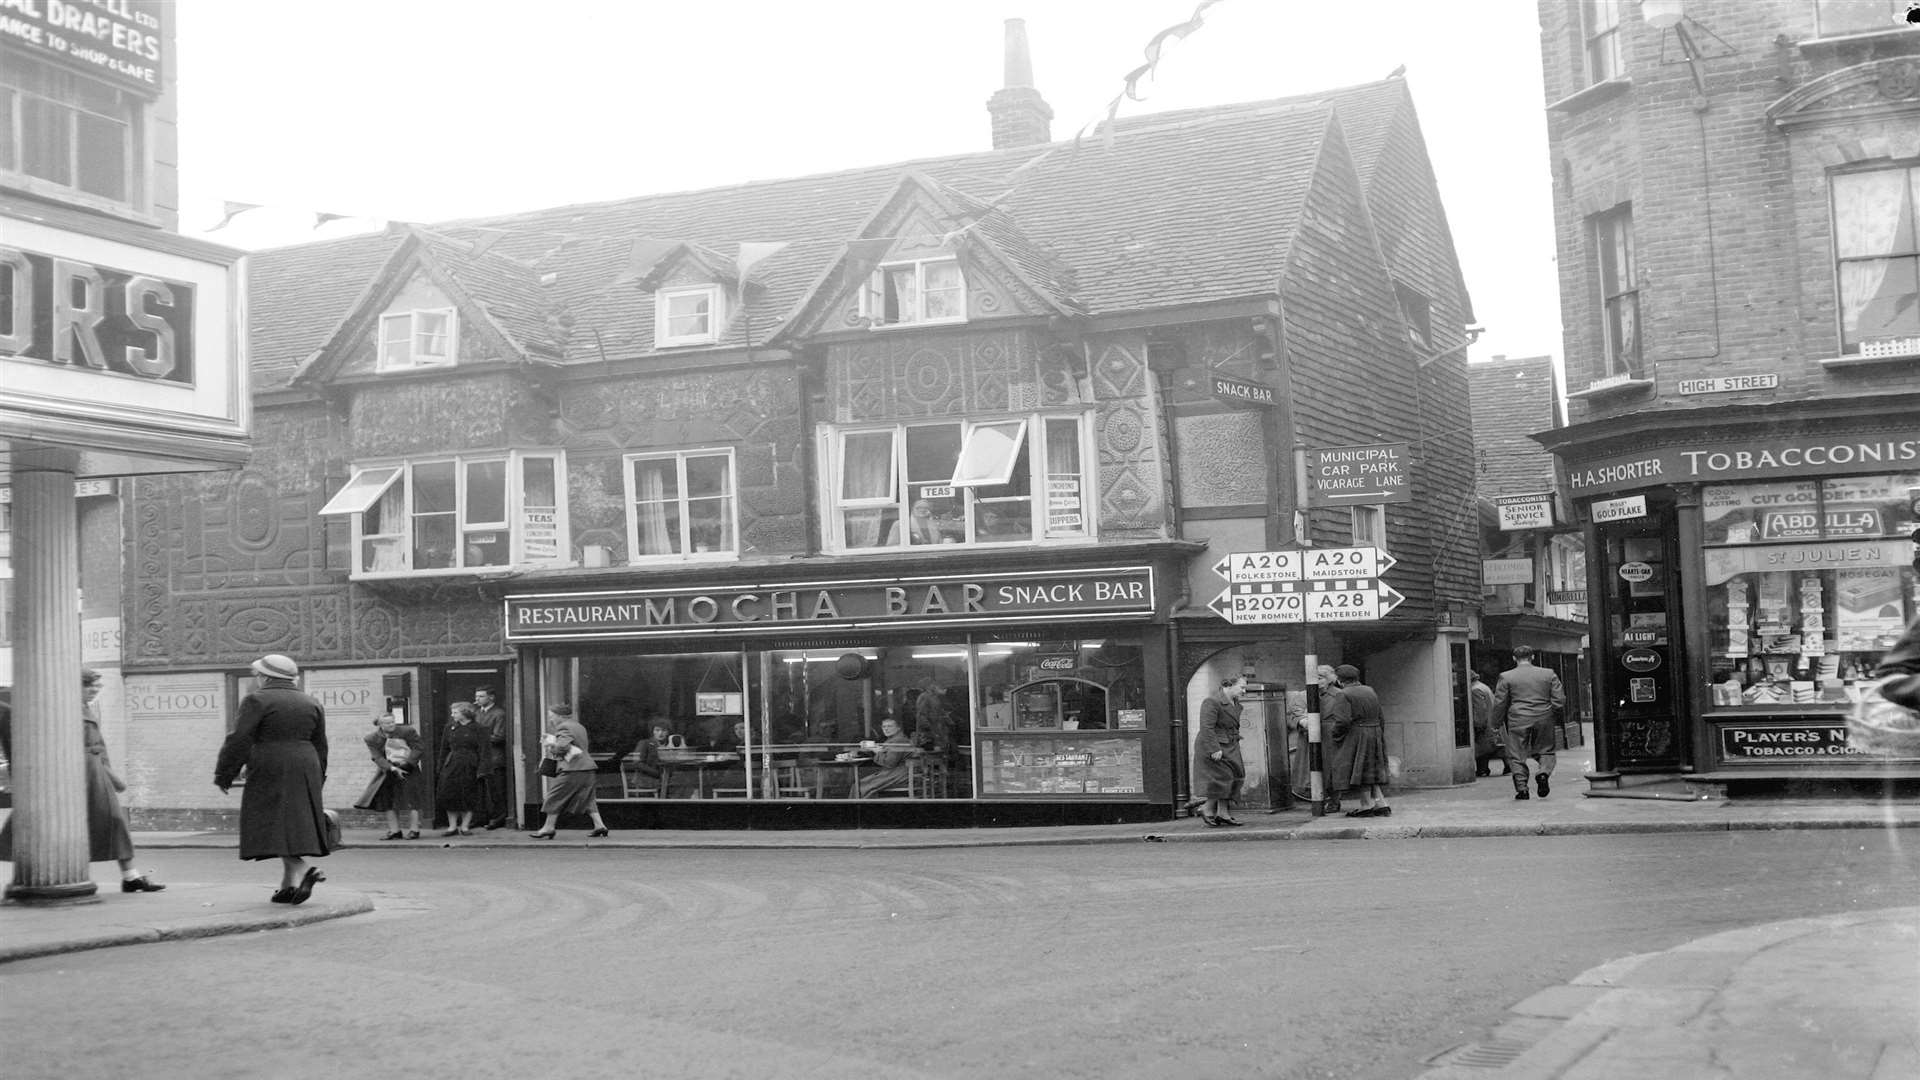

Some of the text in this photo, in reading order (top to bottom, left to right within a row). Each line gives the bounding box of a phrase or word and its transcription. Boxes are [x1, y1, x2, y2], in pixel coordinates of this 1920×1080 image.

[48, 0, 159, 61] DRAPERS
[46, 31, 67, 51] TO
[70, 42, 109, 66] SHOP
[1681, 376, 1775, 393] HIGH STREET
[1217, 381, 1273, 402] SNACK BAR
[1320, 449, 1399, 463] MUNICIPAL
[1322, 462, 1398, 477] CAR PARK
[1317, 475, 1404, 490] VICARAGE LANE
[926, 487, 951, 496] TEAS
[1498, 495, 1547, 505] TOBACCONIST
[1752, 494, 1781, 504] CUT
[1505, 504, 1543, 513] SENIOR
[1597, 505, 1642, 519] GOLD FLAKE
[528, 515, 552, 523] TEAS
[1504, 511, 1545, 521] SERVICE
[1783, 528, 1864, 536] CIGARTTES
[1242, 555, 1288, 569] A20
[1315, 551, 1363, 566] A20
[1793, 548, 1881, 563] JULIEN
[1236, 571, 1297, 580] FOLKESTONE
[1313, 569, 1368, 577] MAIDSTONE
[1839, 571, 1897, 579] NOSEGAY
[519, 581, 1144, 626] RESTAURANT MOCHA BAR SNACK BAR
[1236, 596, 1300, 611] B2070
[1319, 593, 1364, 608] A28
[1236, 612, 1300, 622] NEW ROMNEY
[1314, 610, 1371, 619] TENTERDEN
[1635, 632, 1656, 641] LIGHT
[1040, 657, 1074, 669] Coca-Cola
[131, 695, 218, 711] SCHOOL
[1734, 730, 1820, 743] PLAYER'S
[1743, 746, 1815, 756] TOBACCO
[1828, 745, 1868, 755] CIGA
